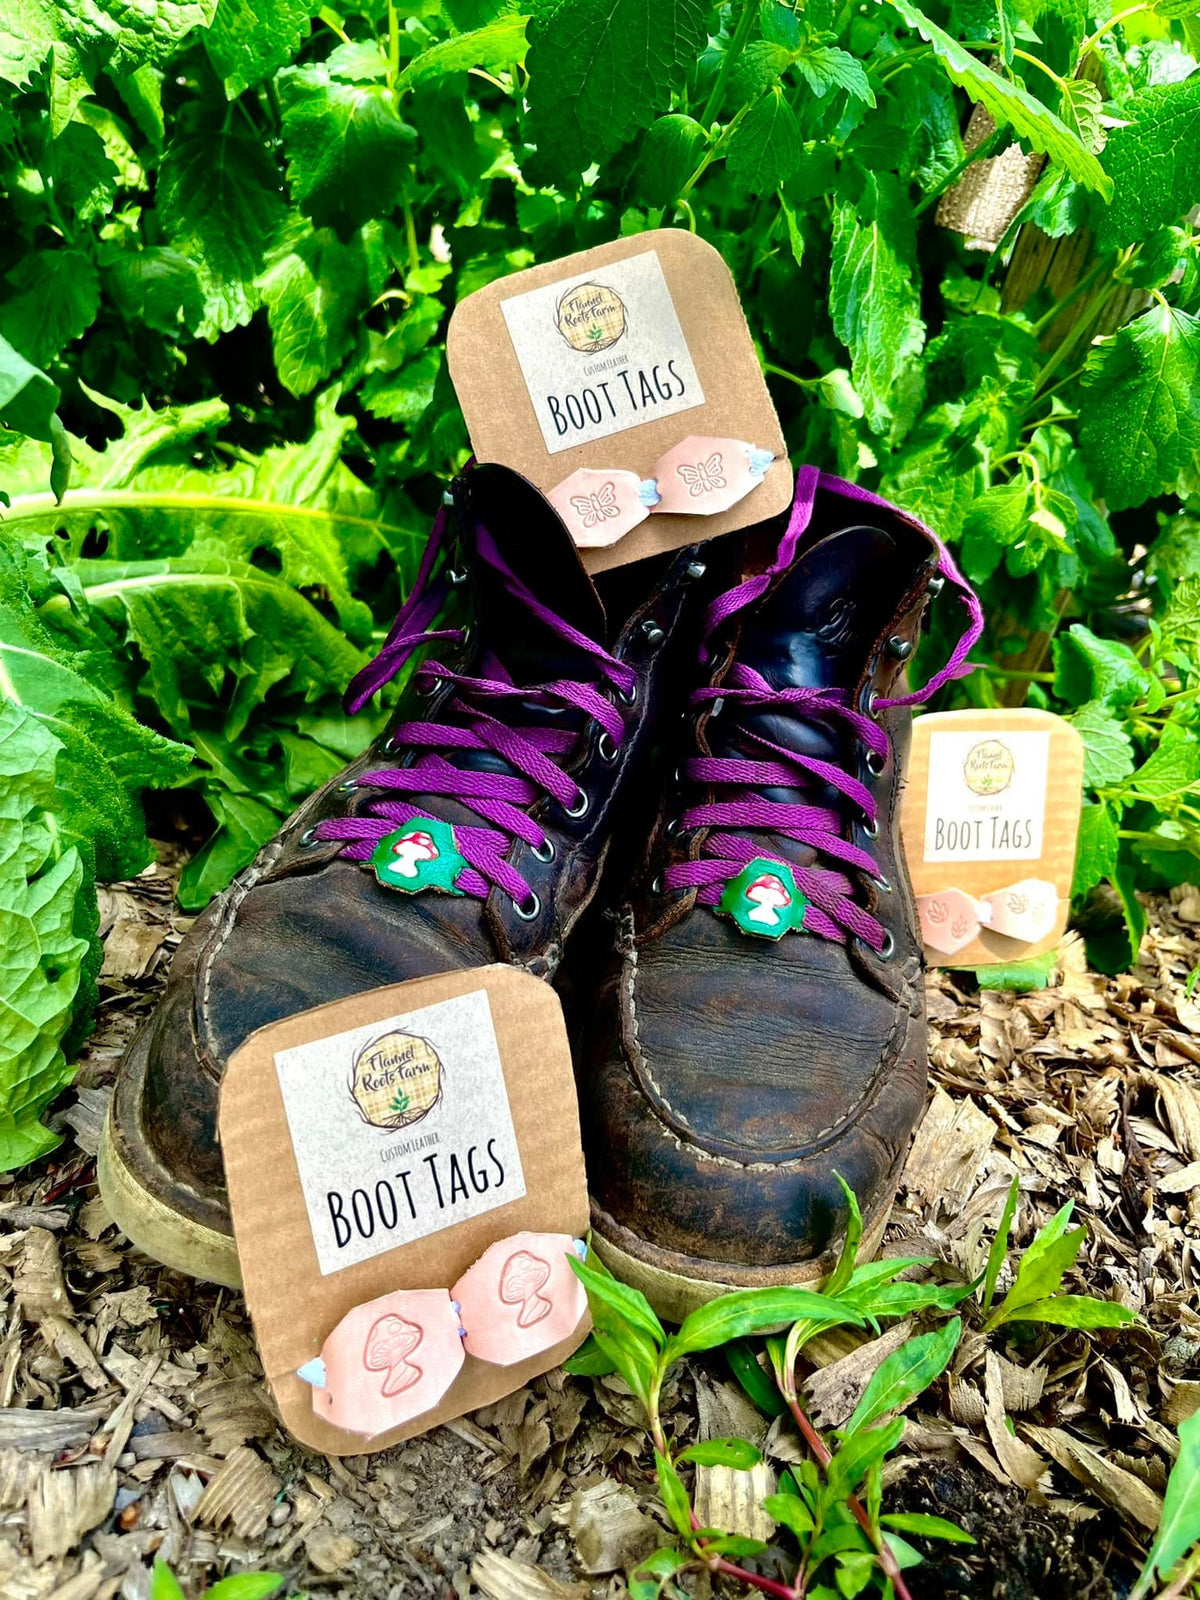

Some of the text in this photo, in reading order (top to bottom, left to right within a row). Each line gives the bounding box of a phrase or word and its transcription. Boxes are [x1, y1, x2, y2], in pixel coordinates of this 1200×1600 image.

[564, 303, 616, 327] Roots Farm
[566, 292, 603, 313] Flannel
[547, 382, 617, 436] BOOT
[935, 817, 982, 851] BOOT
[366, 1044, 415, 1071] Flannel
[362, 1059, 430, 1091] Roots Farm
[327, 1171, 417, 1249] BOOT
